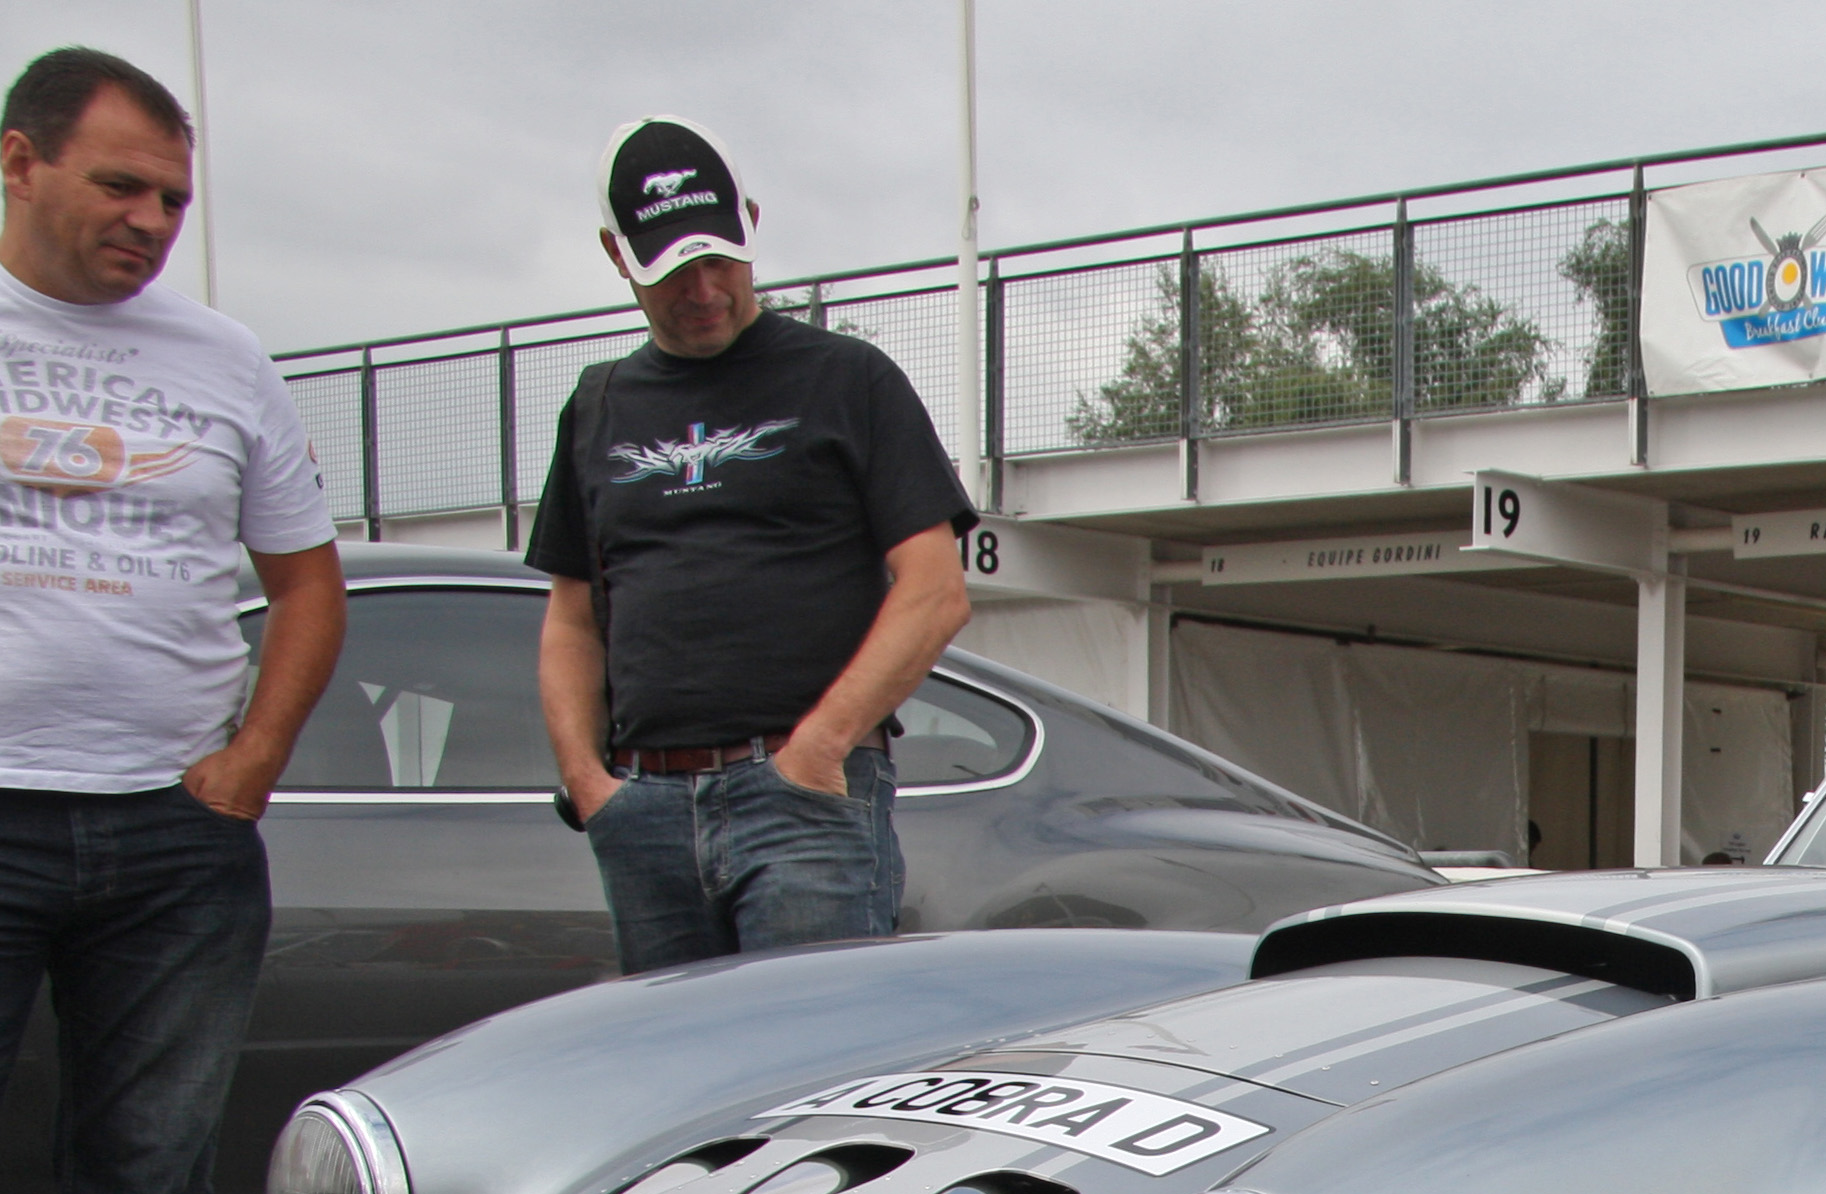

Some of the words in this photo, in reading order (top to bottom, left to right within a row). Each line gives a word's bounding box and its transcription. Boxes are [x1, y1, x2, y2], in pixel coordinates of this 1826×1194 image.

[636, 191, 719, 223] MUSTANG
[1702, 260, 1764, 317] GOOD
[1746, 313, 1801, 341] Breakfast
[0, 360, 213, 438] ERICAN
[20, 427, 103, 478] 76
[1482, 486, 1521, 539] 19
[961, 531, 999, 575] 18
[1742, 527, 1762, 545] 19
[117, 553, 160, 578] OIL
[166, 558, 191, 582] 76
[1210, 557, 1225, 573] 18
[1307, 549, 1364, 568] EQUIPE
[1371, 543, 1442, 563] GORDINI
[2, 571, 76, 592] SERVICE
[85, 577, 134, 597] AREA
[781, 1079, 880, 1111] A
[852, 1077, 1135, 1137] COBRA
[1107, 1113, 1222, 1157] D
